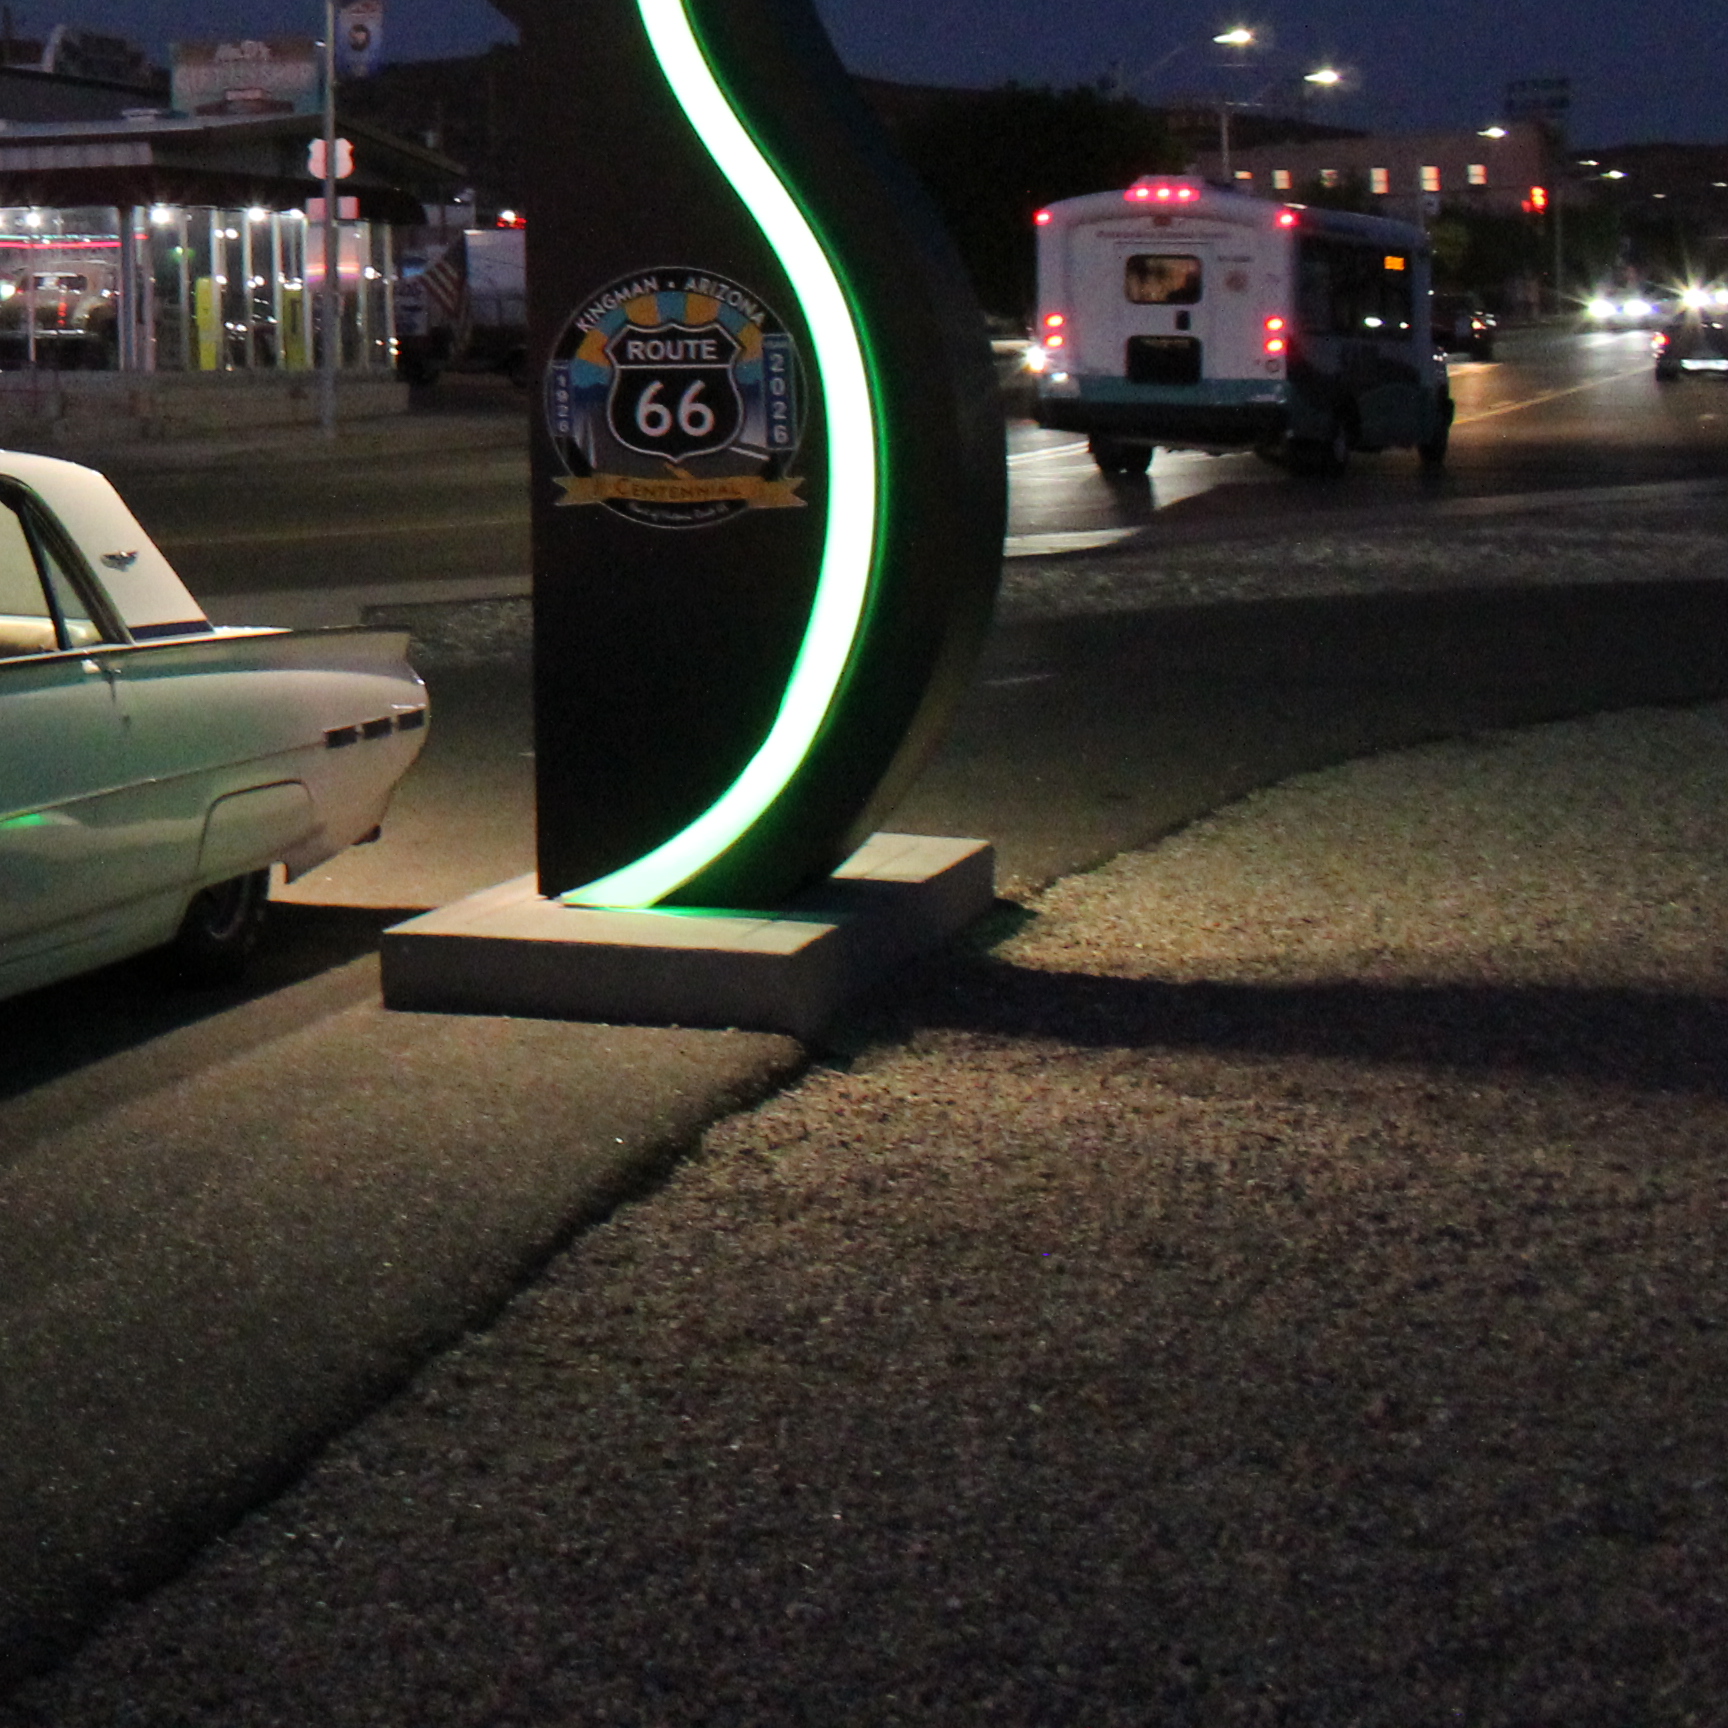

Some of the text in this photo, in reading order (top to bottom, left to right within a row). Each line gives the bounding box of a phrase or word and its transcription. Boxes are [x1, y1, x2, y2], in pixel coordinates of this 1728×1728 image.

[575, 277, 767, 332] KINGMAN ARIZONA
[627, 339, 718, 361] ROUTE
[635, 380, 716, 438] 66
[768, 352, 788, 444] 2026
[613, 478, 742, 498] CENTENNIAL
